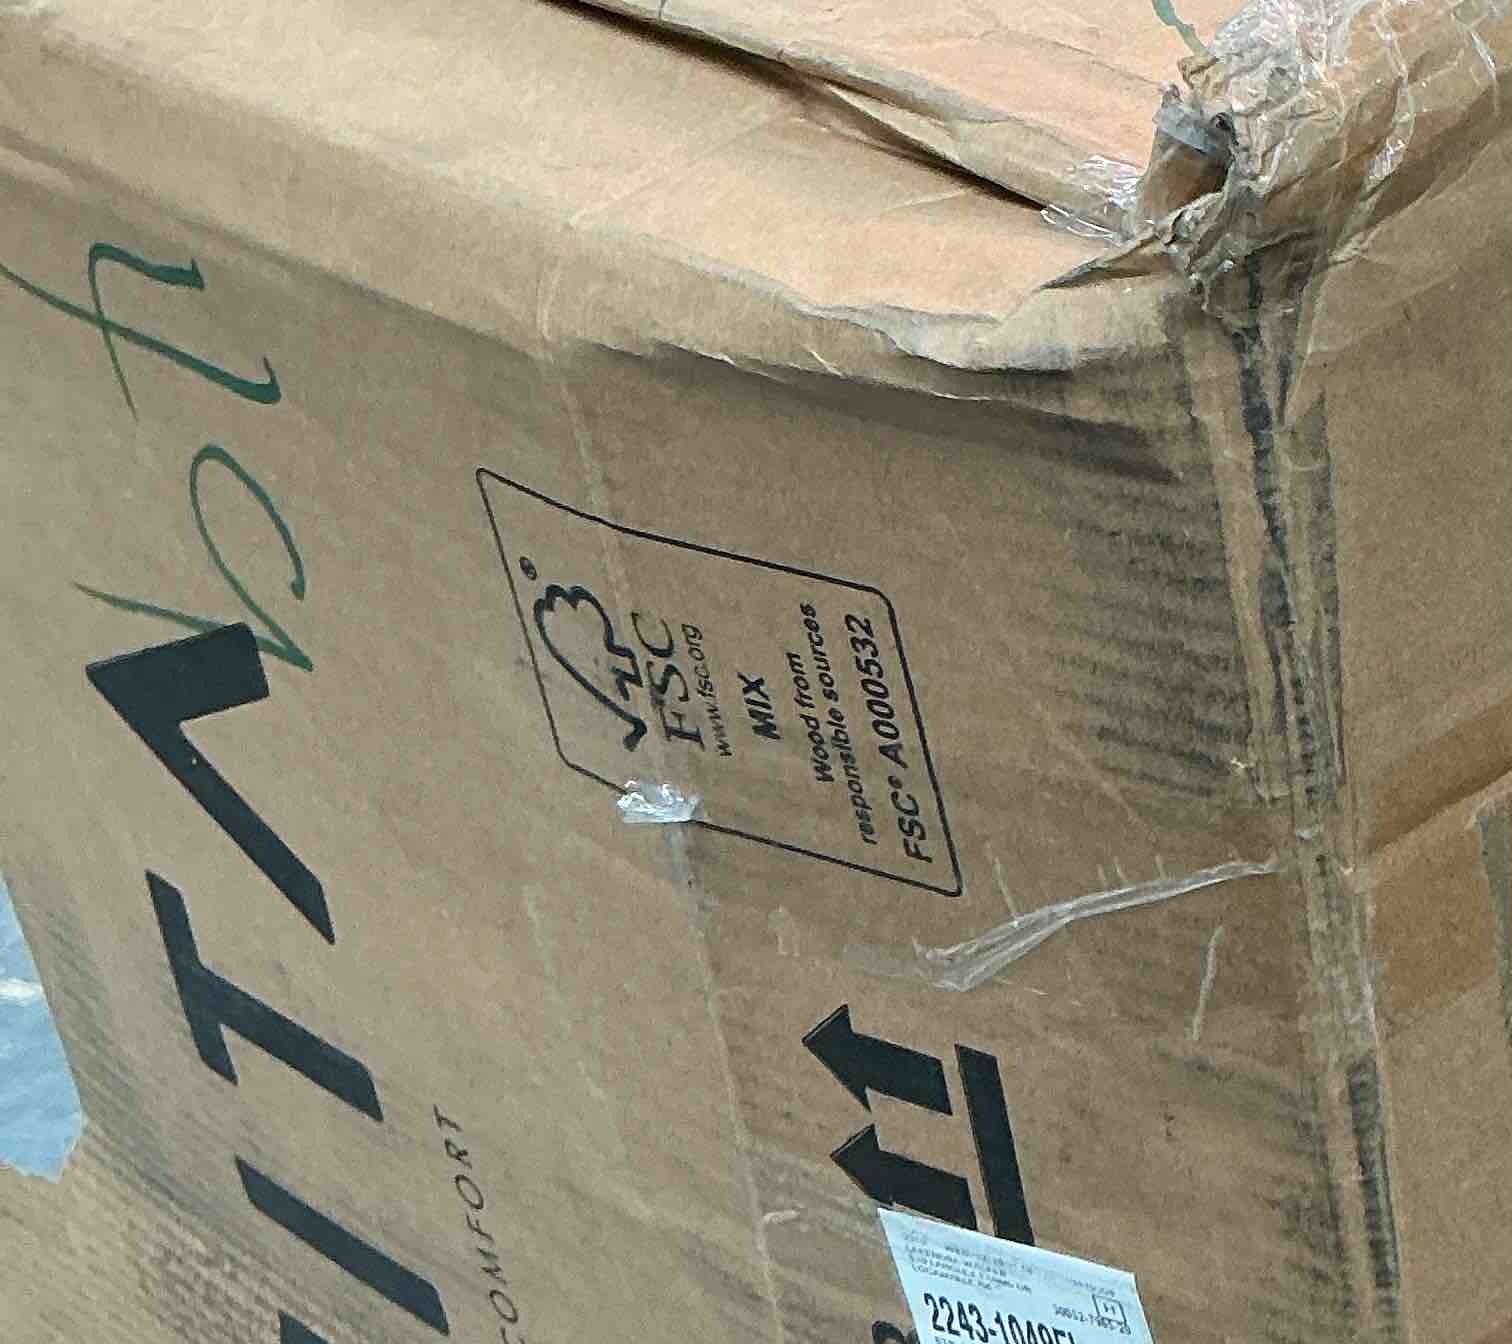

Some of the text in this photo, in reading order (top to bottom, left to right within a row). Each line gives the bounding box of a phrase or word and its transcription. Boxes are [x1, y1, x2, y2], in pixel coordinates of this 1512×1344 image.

[630, 612, 706, 751] FSC
[737, 671, 782, 741] MIX
[784, 651, 836, 784] Wood from
[799, 601, 879, 845] responsible sources
[843, 613, 907, 768] A000532
